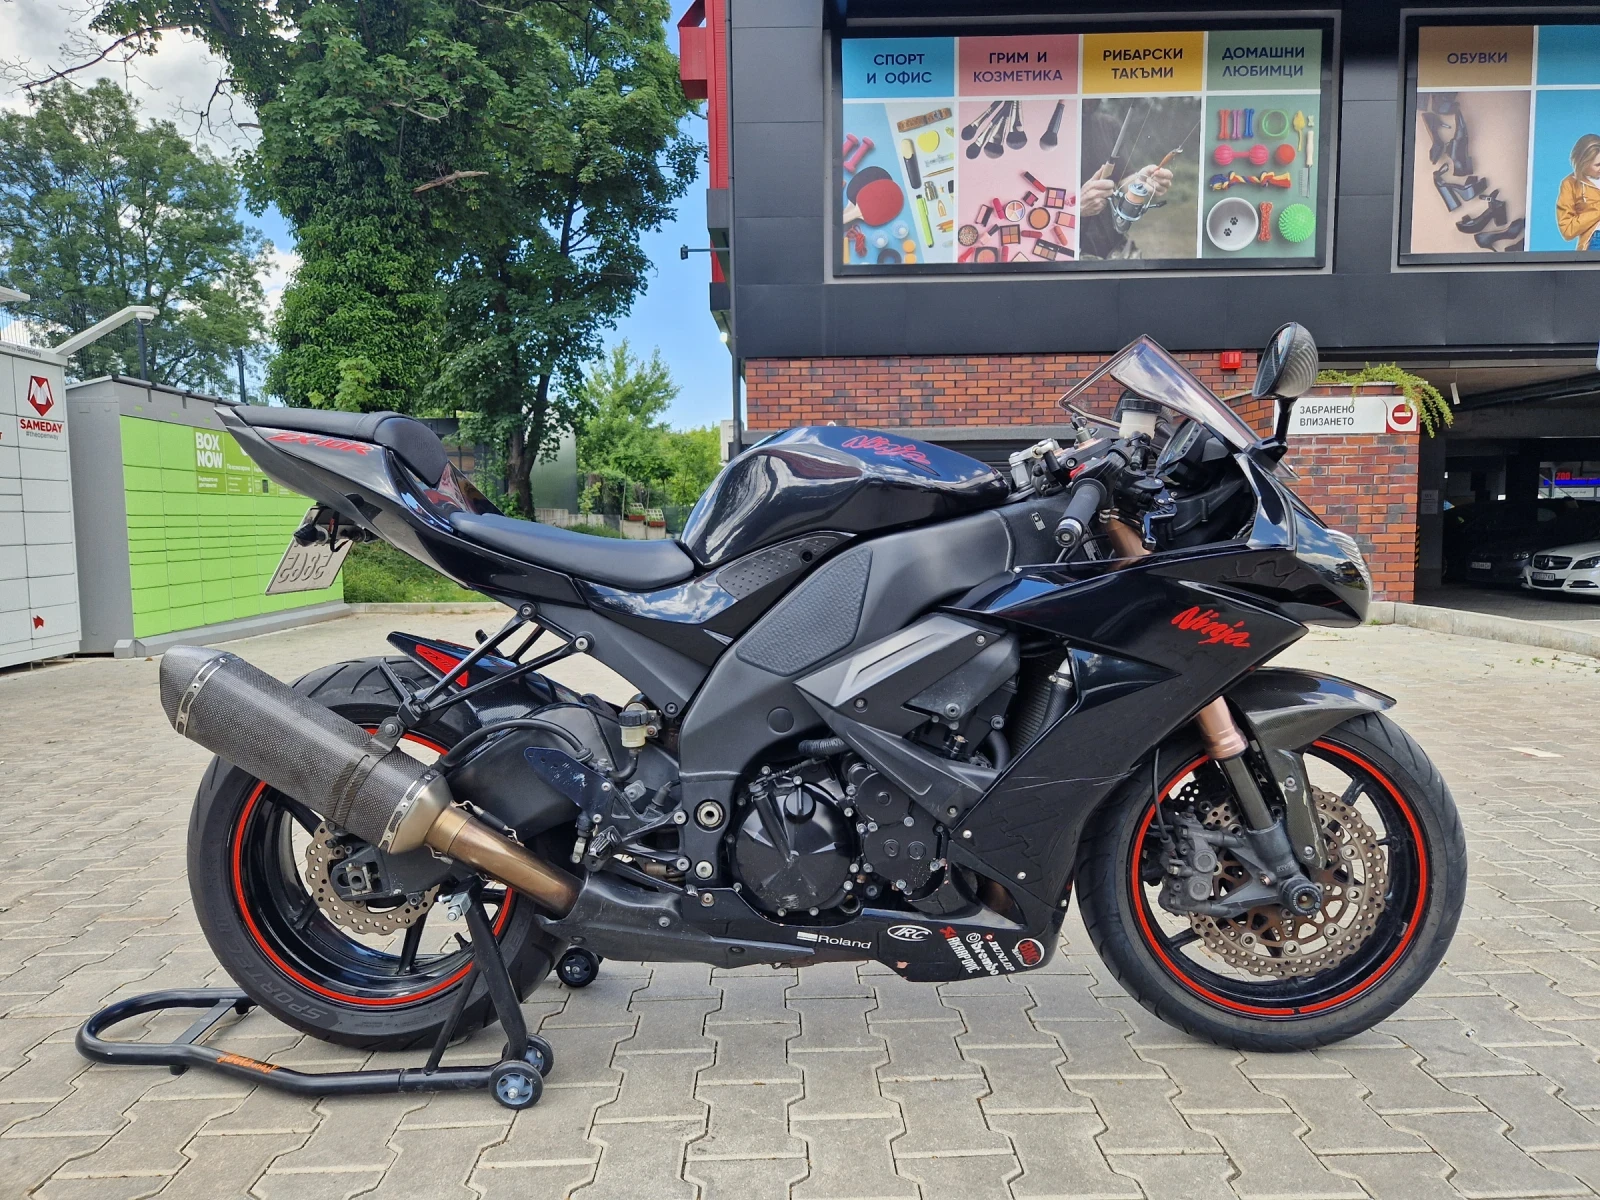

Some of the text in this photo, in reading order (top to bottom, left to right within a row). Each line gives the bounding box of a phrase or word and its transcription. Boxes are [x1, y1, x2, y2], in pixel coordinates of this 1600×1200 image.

[873, 53, 925, 66] СПОРТ
[989, 51, 1047, 64] ГРИМ И
[1103, 48, 1183, 61] РИБАРСКИ
[1222, 46, 1305, 60] ДОМАШНИ
[1447, 52, 1508, 65] ОБУВКИ
[866, 71, 932, 85] И ОФИС
[973, 69, 1063, 83] КОЗМЕТИКА
[1111, 67, 1174, 79] ТАКЪМИ
[1222, 65, 1304, 78] ЛЮБИМЦИ
[1300, 405, 1355, 414] ЗАБРАНЕНО
[20, 418, 63, 433] SAMEDAY
[1300, 417, 1355, 426] ВЛИЗАНЕТО
[195, 431, 220, 451] BOX
[841, 434, 931, 465] Ninja
[196, 450, 223, 469] NOW
[1171, 605, 1251, 648] Ninja
[893, 926, 929, 940] IRC
[818, 934, 872, 950] Roland
[970, 940, 999, 976] brembo
[988, 941, 1016, 972] DUNLOP
[1018, 940, 1040, 965] BMC
